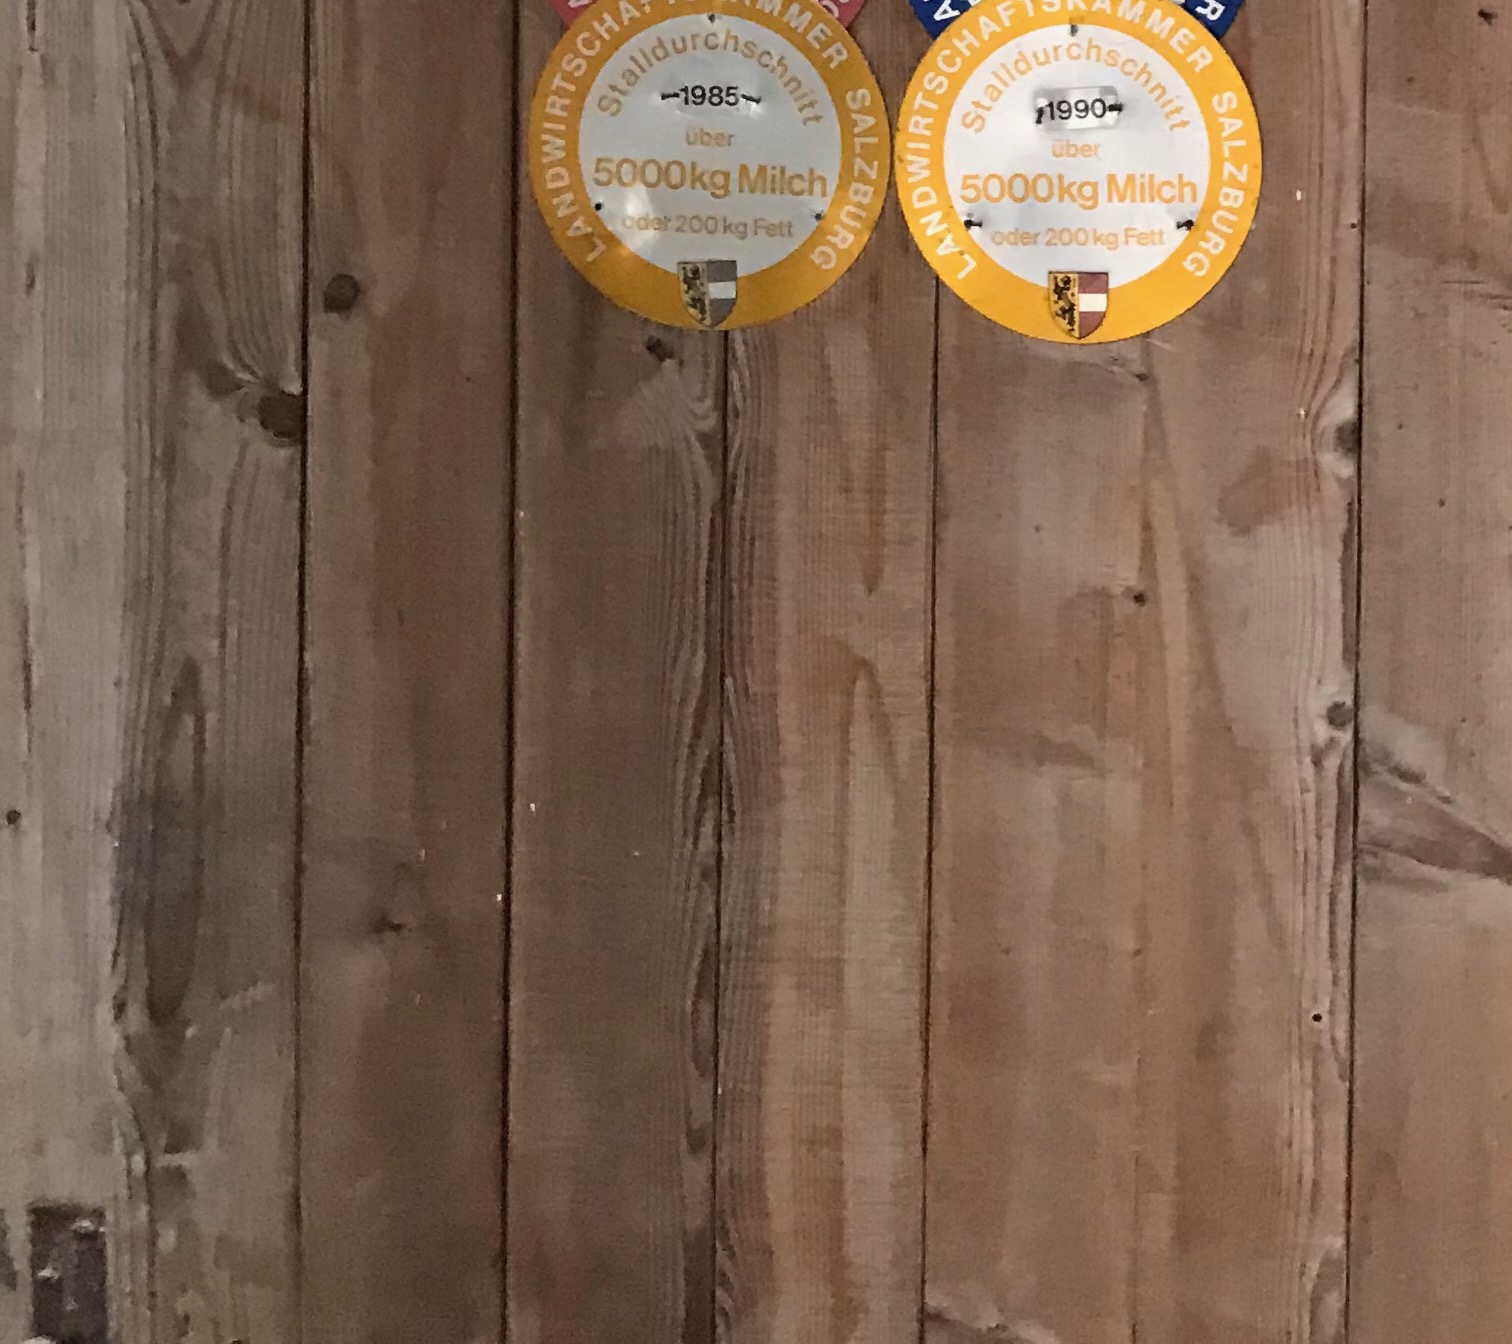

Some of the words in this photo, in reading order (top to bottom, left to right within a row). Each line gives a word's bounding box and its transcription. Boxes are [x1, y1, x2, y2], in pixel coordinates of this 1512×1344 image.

[680, 84, 739, 107] 1985
[960, 39, 1189, 135] Stalldurchschnitt
[1046, 99, 1107, 121] 1990
[1052, 140, 1098, 158] über
[739, 164, 826, 196] Milch
[1108, 174, 1196, 203] Milch
[1182, 91, 1248, 278] SALZBURG
